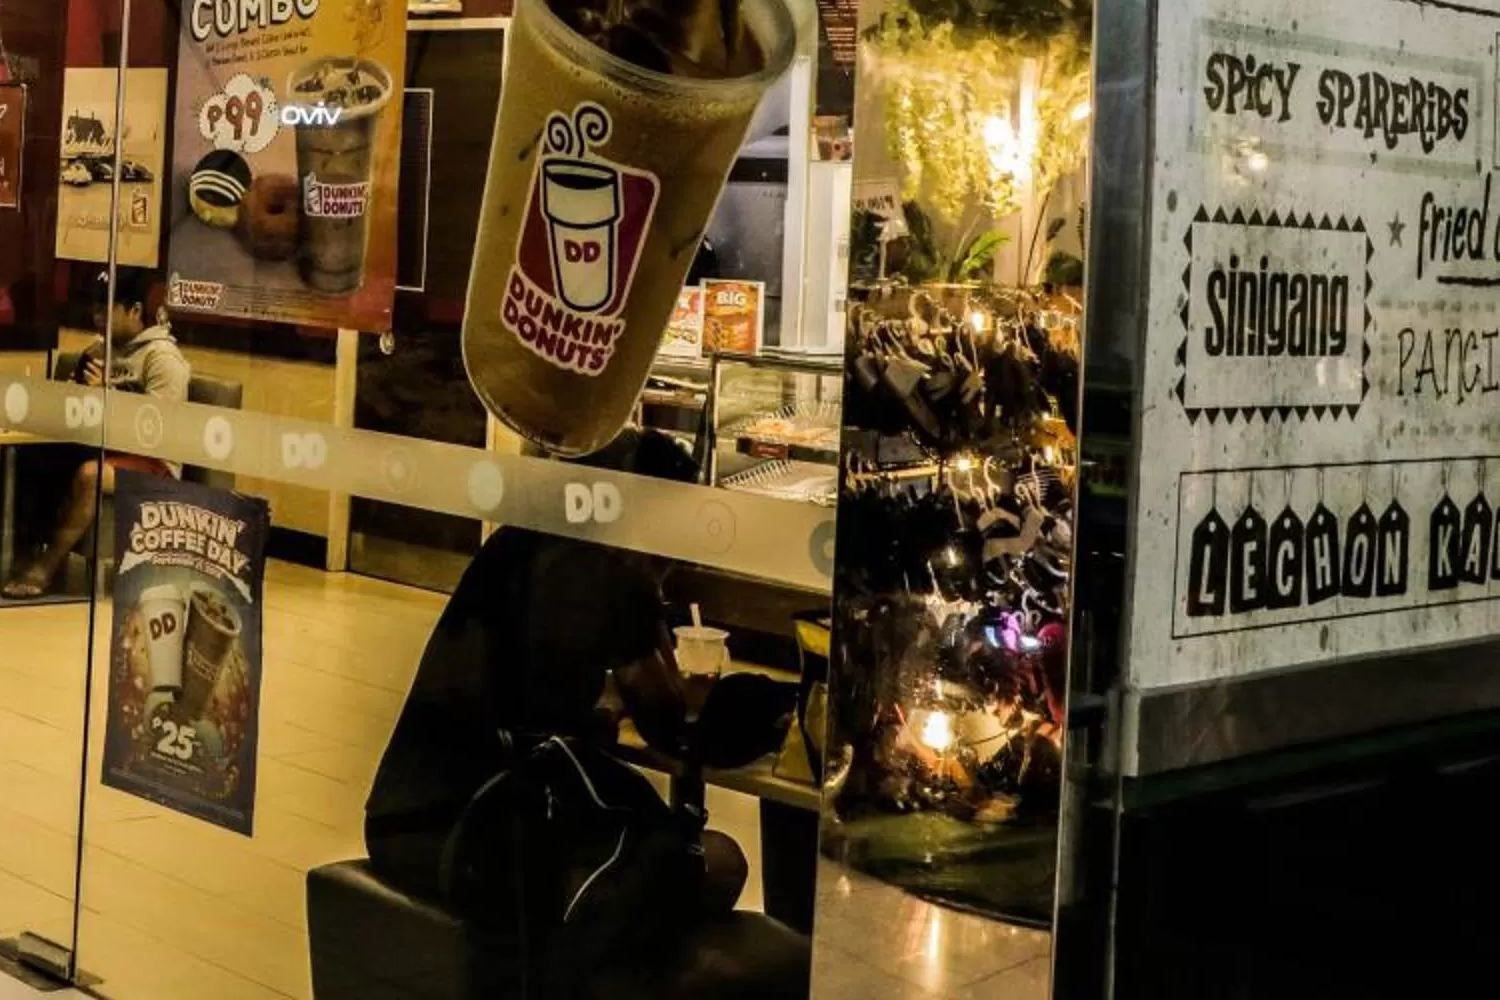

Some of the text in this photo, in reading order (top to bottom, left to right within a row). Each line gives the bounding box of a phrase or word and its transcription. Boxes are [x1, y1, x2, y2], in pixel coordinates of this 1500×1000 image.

[1417, 171, 1492, 280] fried
[563, 239, 601, 264] DD
[509, 270, 622, 346] DUNKIN'
[716, 290, 749, 307] BIG
[503, 295, 606, 370] DONUTS
[64, 395, 101, 428] DD
[281, 433, 328, 469] DD
[563, 482, 624, 524] DD
[130, 528, 207, 555] COFFEE
[206, 539, 251, 575] DAY
[1198, 522, 1500, 605] LECHON KA
[149, 611, 177, 641] DD
